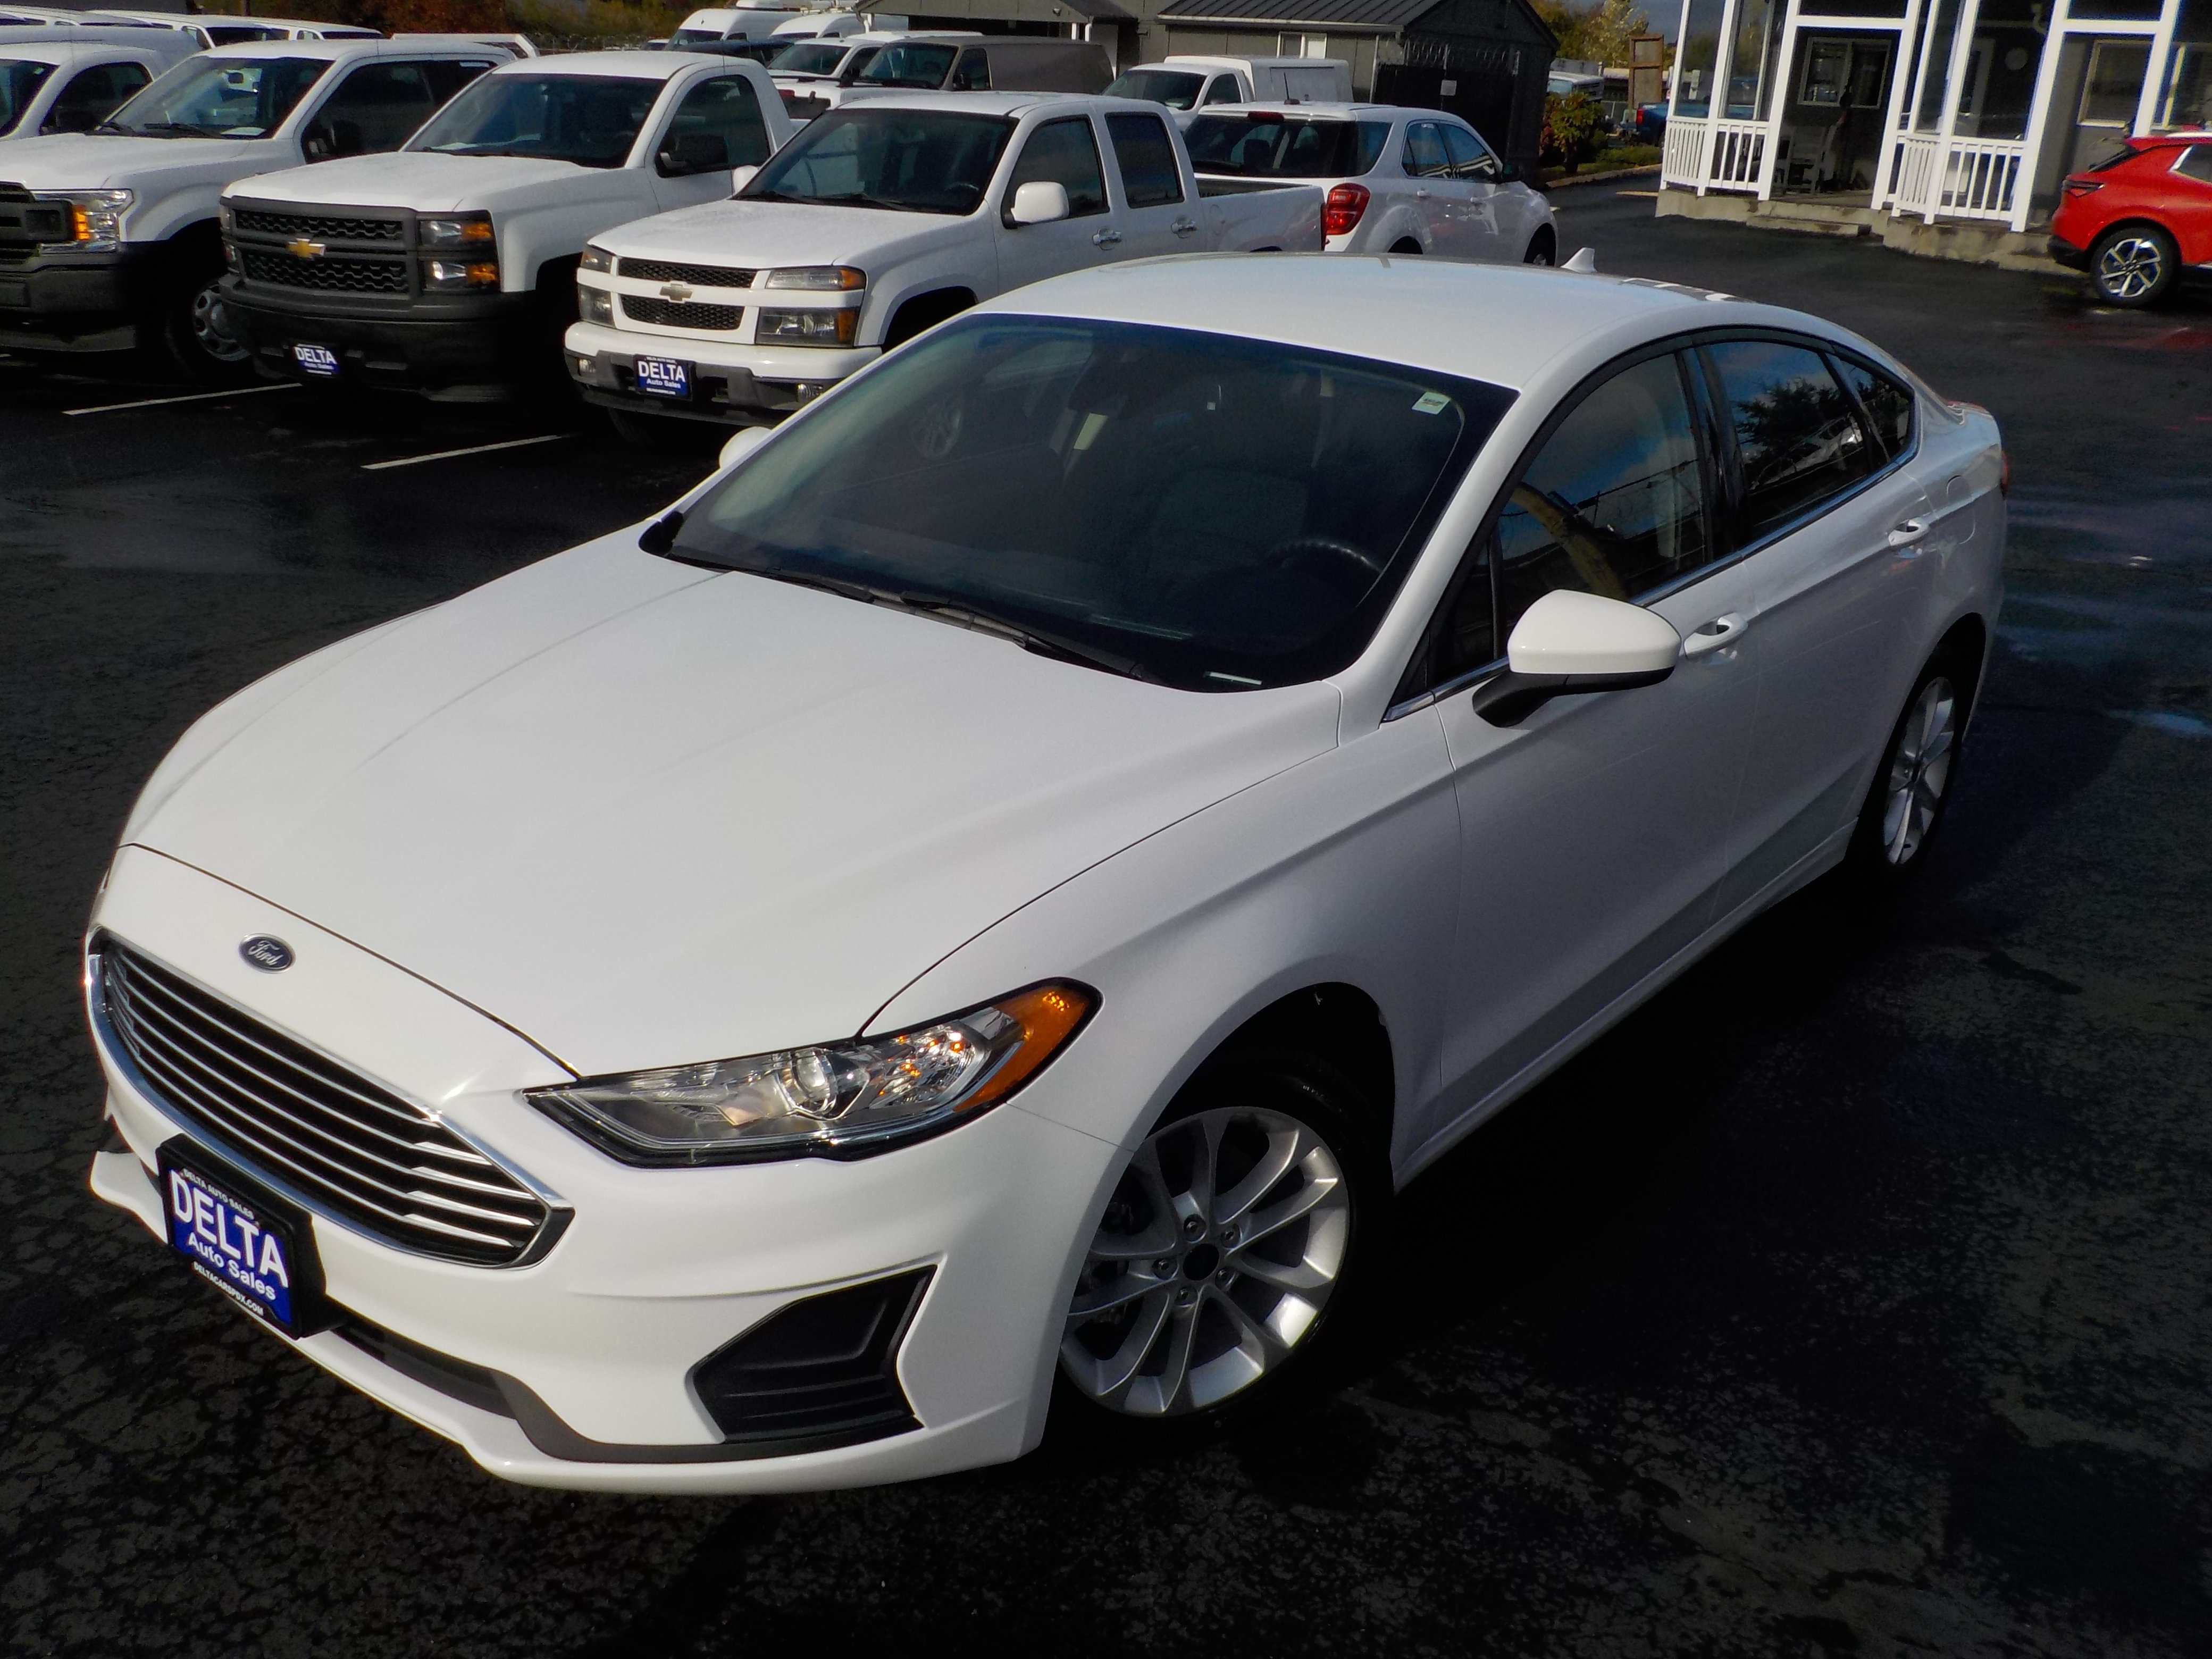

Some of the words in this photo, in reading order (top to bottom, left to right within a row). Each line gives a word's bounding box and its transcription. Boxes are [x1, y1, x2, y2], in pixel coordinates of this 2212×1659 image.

[294, 346, 338, 364] DELTA
[638, 361, 686, 382] DELTA
[248, 940, 283, 965] Ford
[207, 1184, 228, 1203] AUTO
[170, 1169, 289, 1288] DELTA
[188, 1231, 224, 1269] Auto
[228, 1259, 276, 1301] Sales
